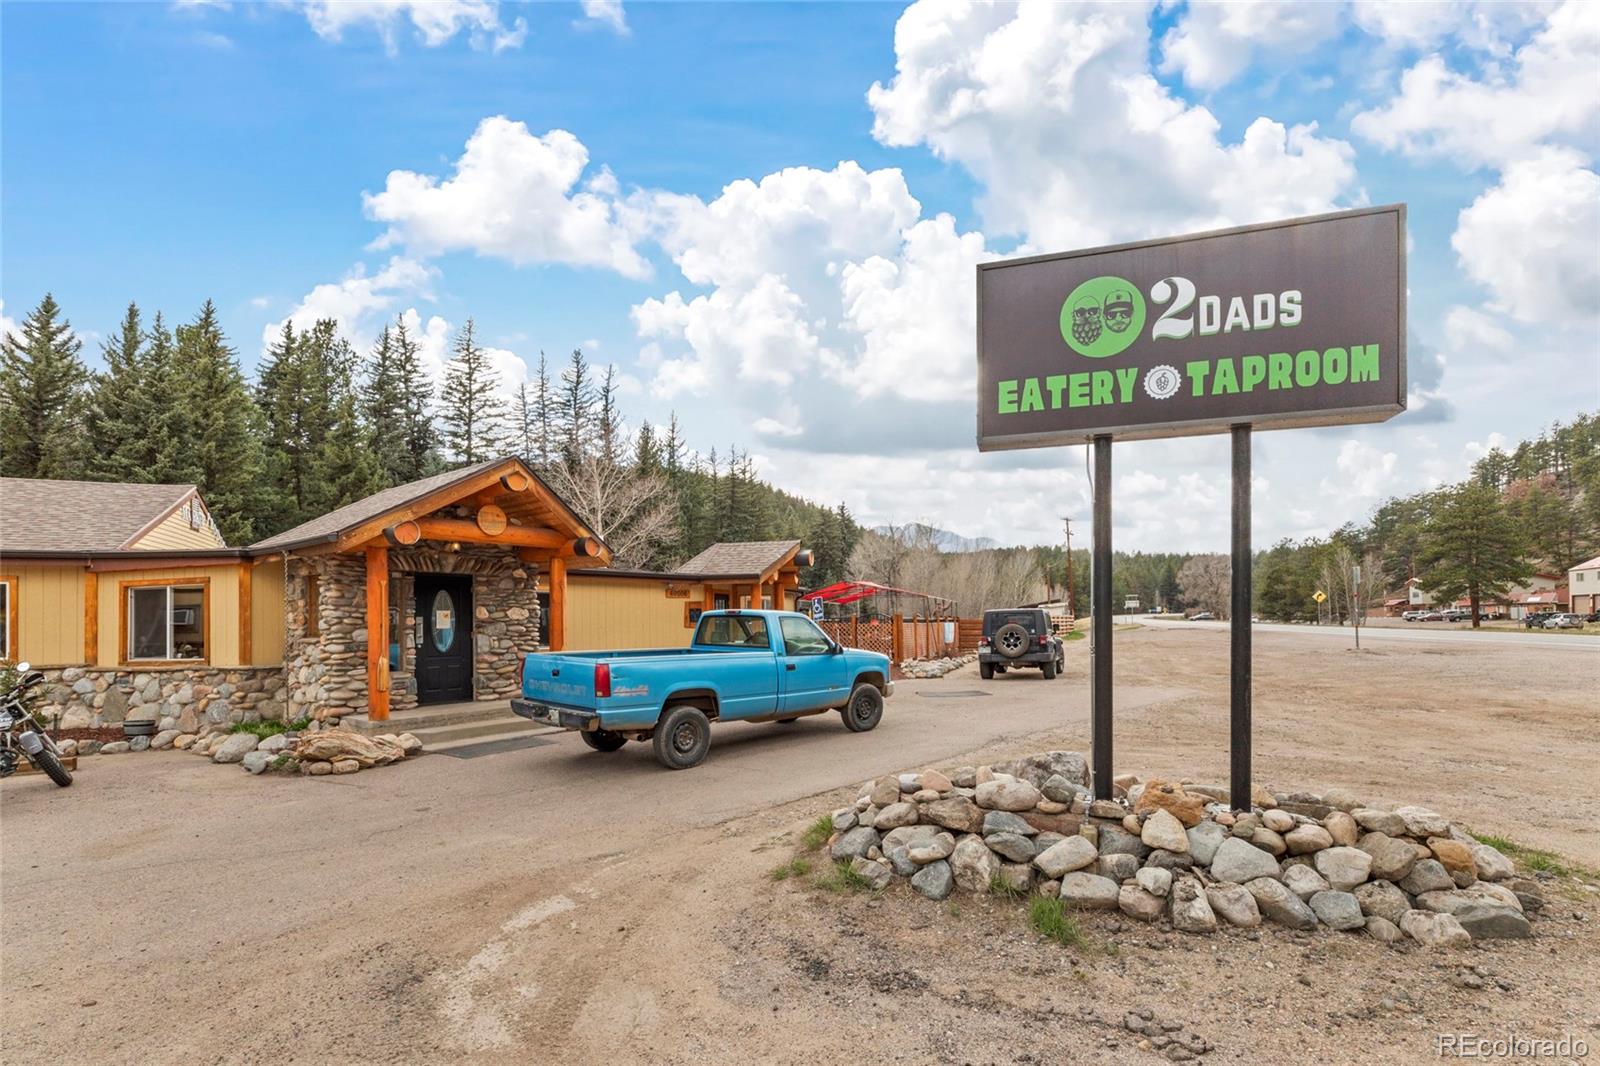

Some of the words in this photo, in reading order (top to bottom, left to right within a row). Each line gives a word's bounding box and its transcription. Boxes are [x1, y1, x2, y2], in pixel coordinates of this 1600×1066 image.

[1150, 276, 1196, 342] 2
[1199, 289, 1302, 336] DADS
[998, 367, 1139, 414] EATERY
[1186, 344, 1380, 397] TAPROOM
